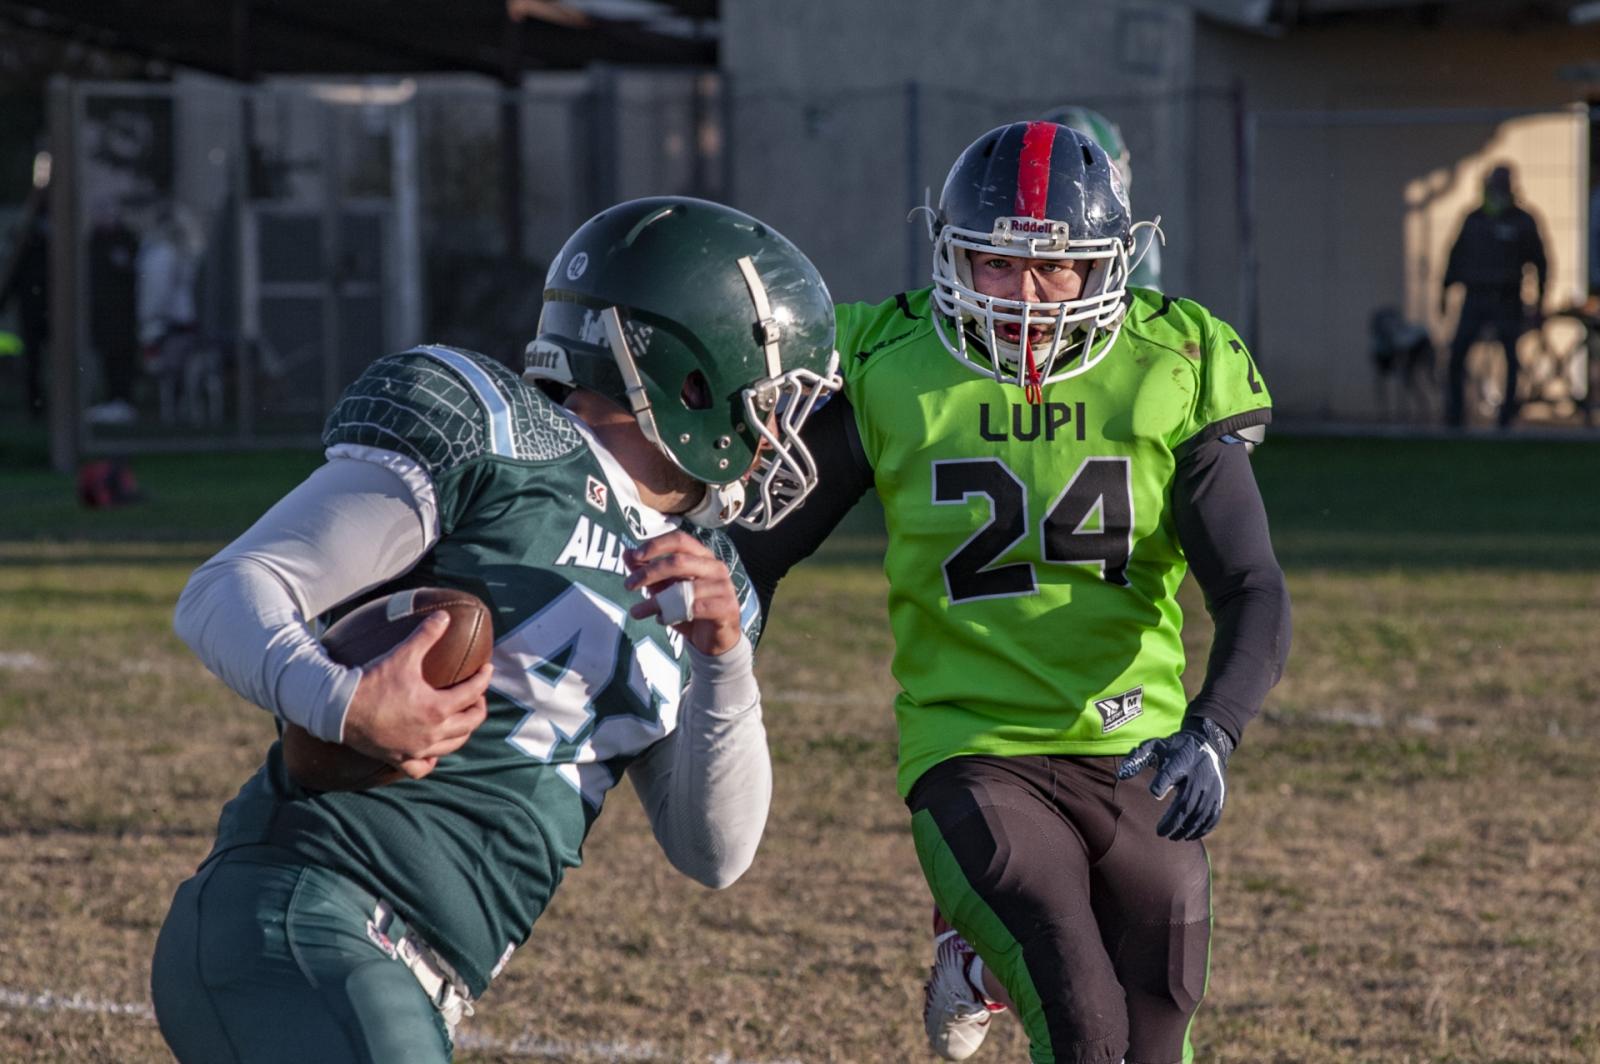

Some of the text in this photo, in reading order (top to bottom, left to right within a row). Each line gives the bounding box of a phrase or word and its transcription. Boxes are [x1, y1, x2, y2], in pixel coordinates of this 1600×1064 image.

[1011, 220, 1053, 234] Riddell
[979, 402, 1086, 442] LUPI
[931, 456, 1135, 605] 24
[488, 580, 682, 814] 42
